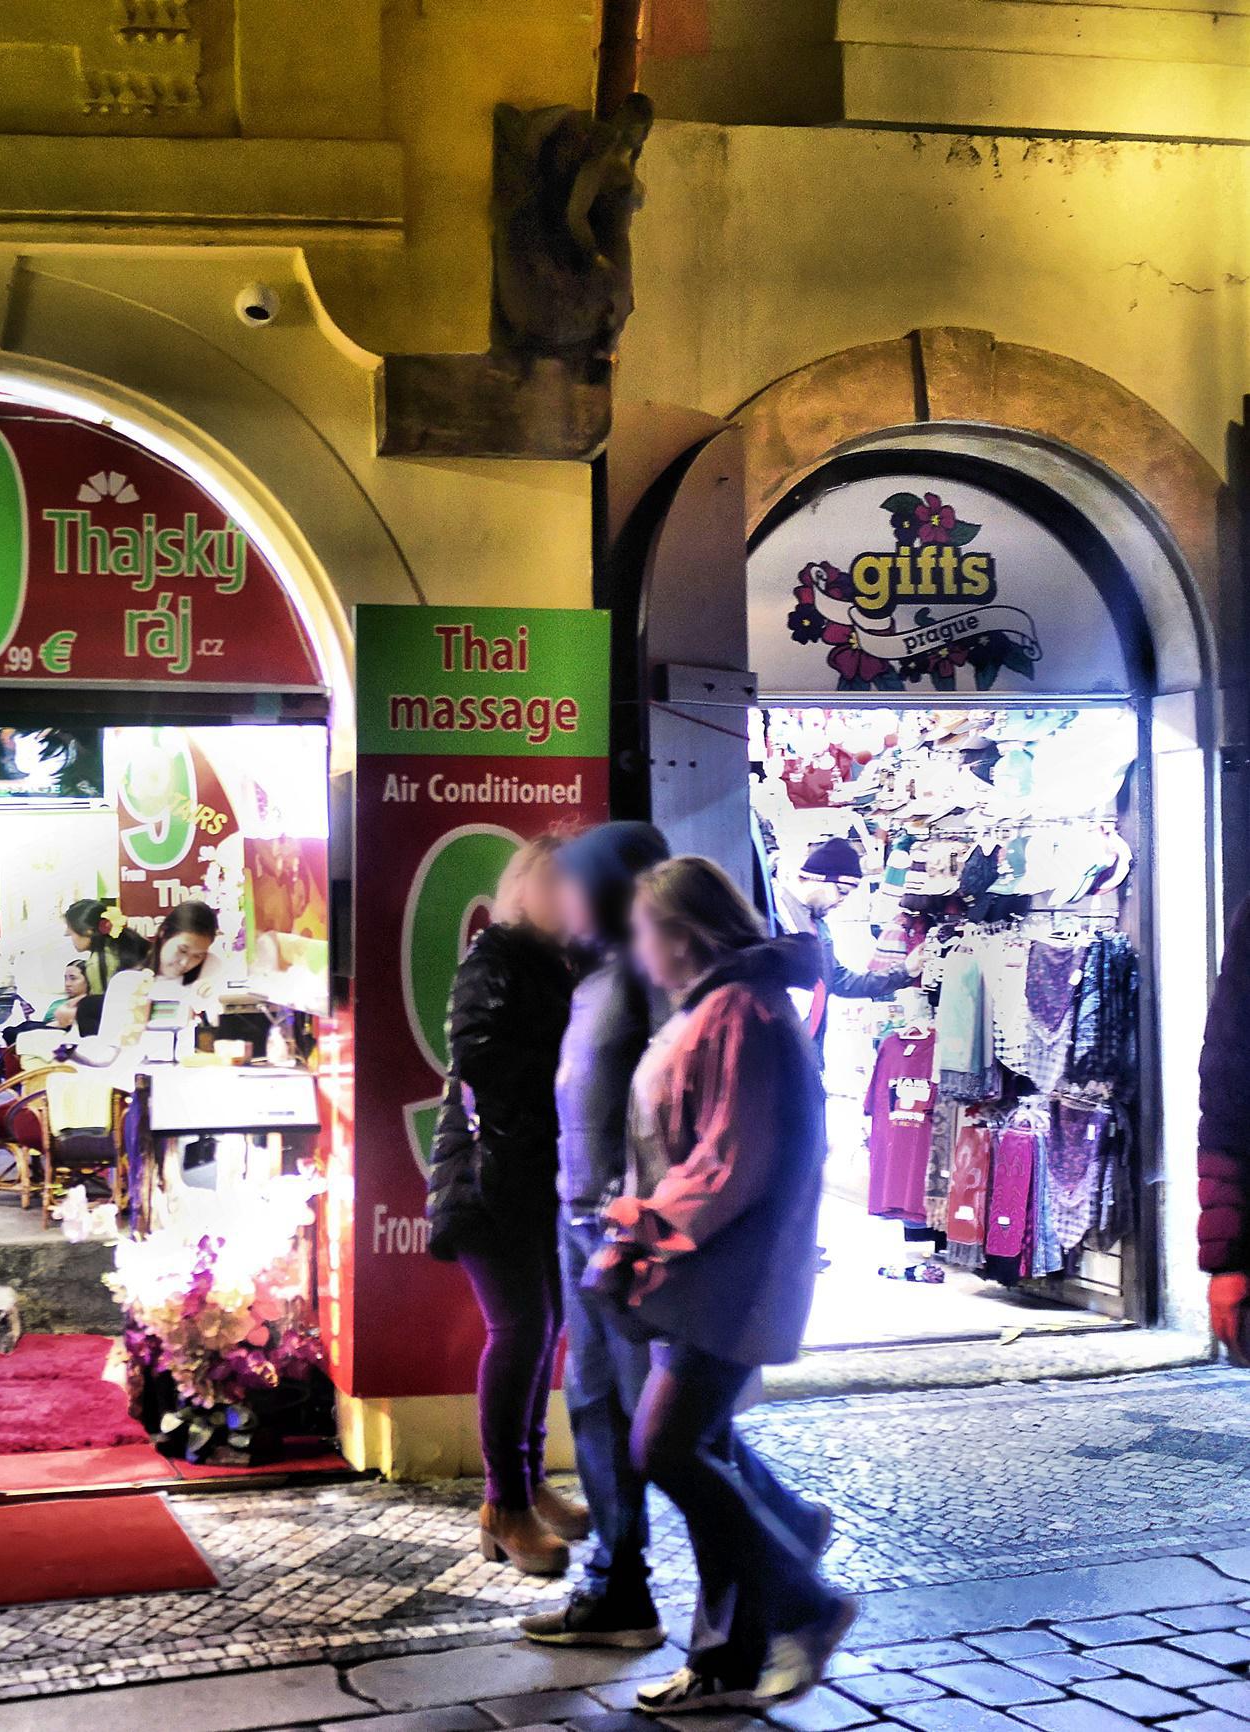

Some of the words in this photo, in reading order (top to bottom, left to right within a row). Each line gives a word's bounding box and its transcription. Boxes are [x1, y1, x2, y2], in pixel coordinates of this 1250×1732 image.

[42, 507, 248, 594] Thajský
[853, 545, 990, 609] gifts
[124, 592, 192, 674] ráj
[434, 623, 529, 673] Thai
[902, 615, 980, 655] prague
[389, 694, 580, 745] massage
[382, 773, 421, 802] Air
[428, 773, 582, 804] Conditioned
